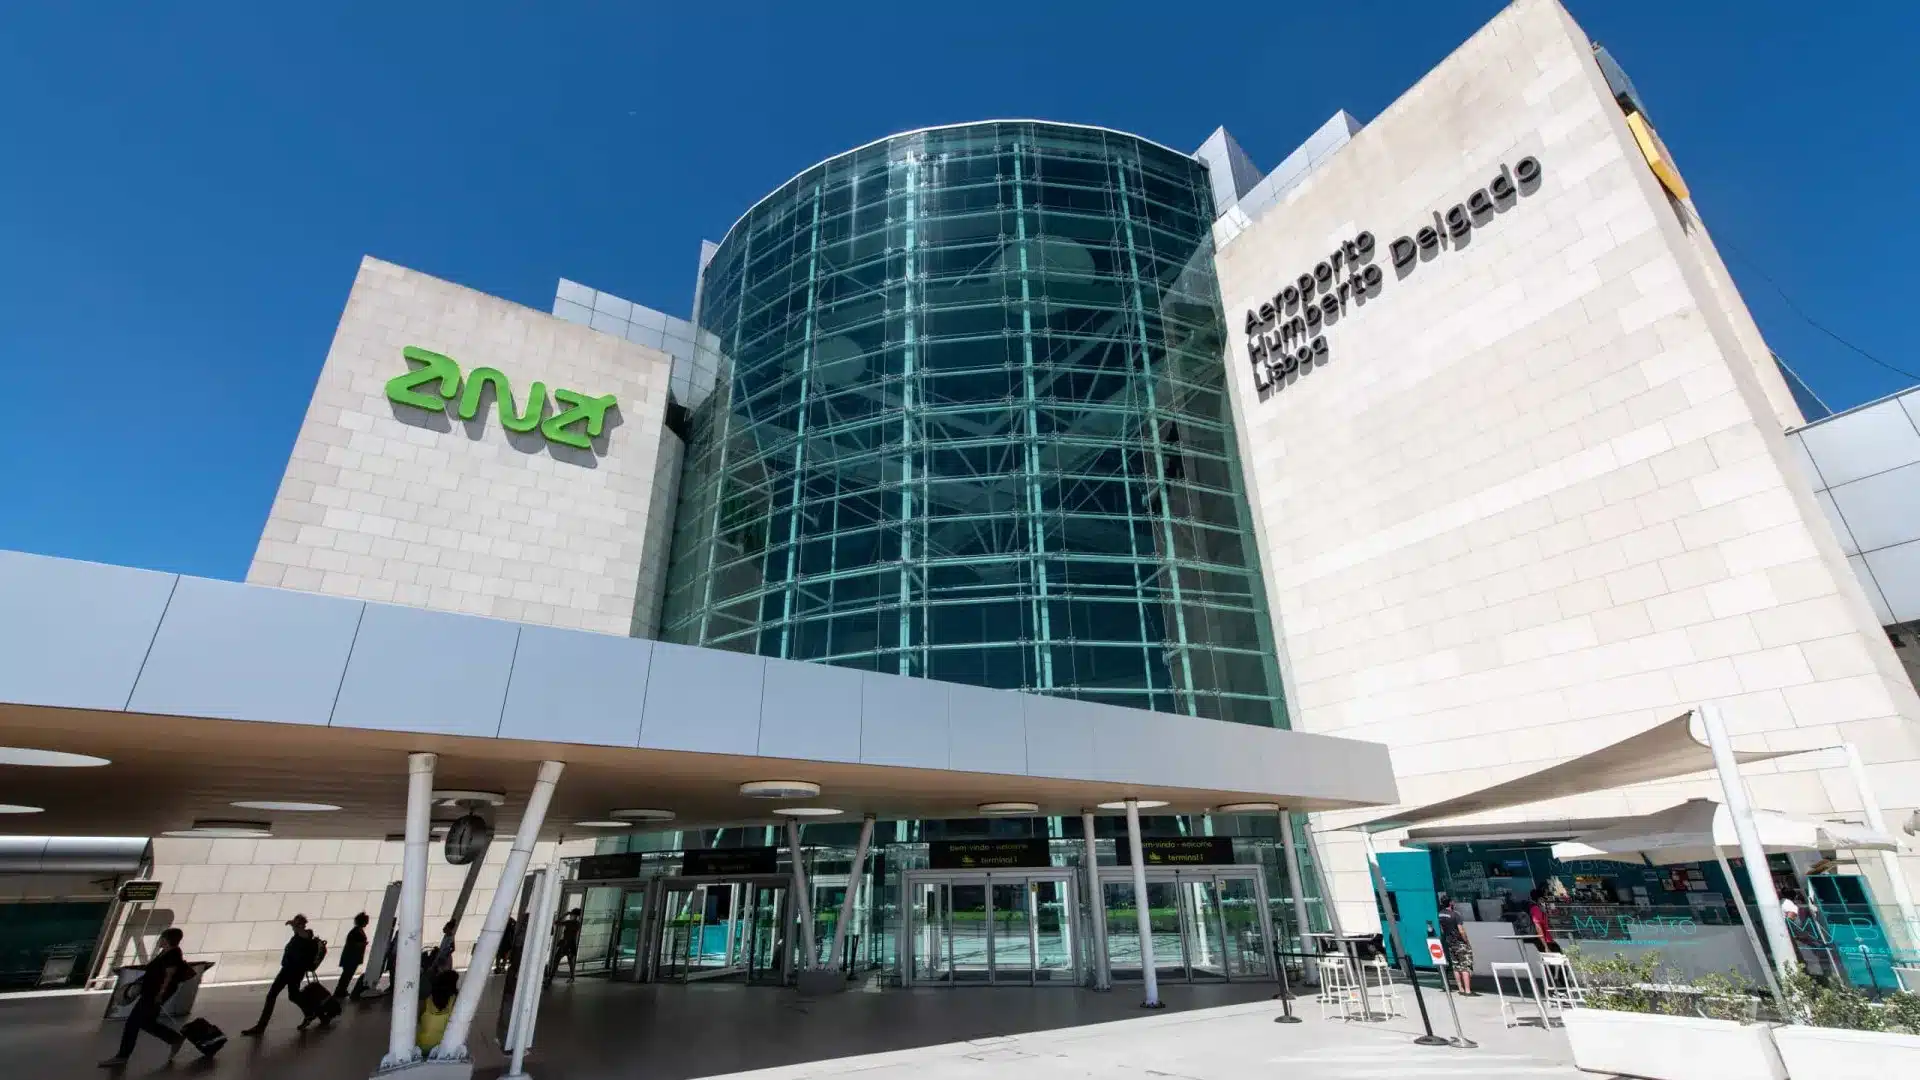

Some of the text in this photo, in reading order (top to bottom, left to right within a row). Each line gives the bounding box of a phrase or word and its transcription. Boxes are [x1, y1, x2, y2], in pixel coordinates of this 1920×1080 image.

[1245, 230, 1375, 333] Aeroporto
[1248, 155, 1542, 364] Humberto Delgado
[1253, 335, 1329, 396] Lisboa
[1168, 852, 1199, 862] terminal
[1573, 914, 1697, 937] My Bistro
